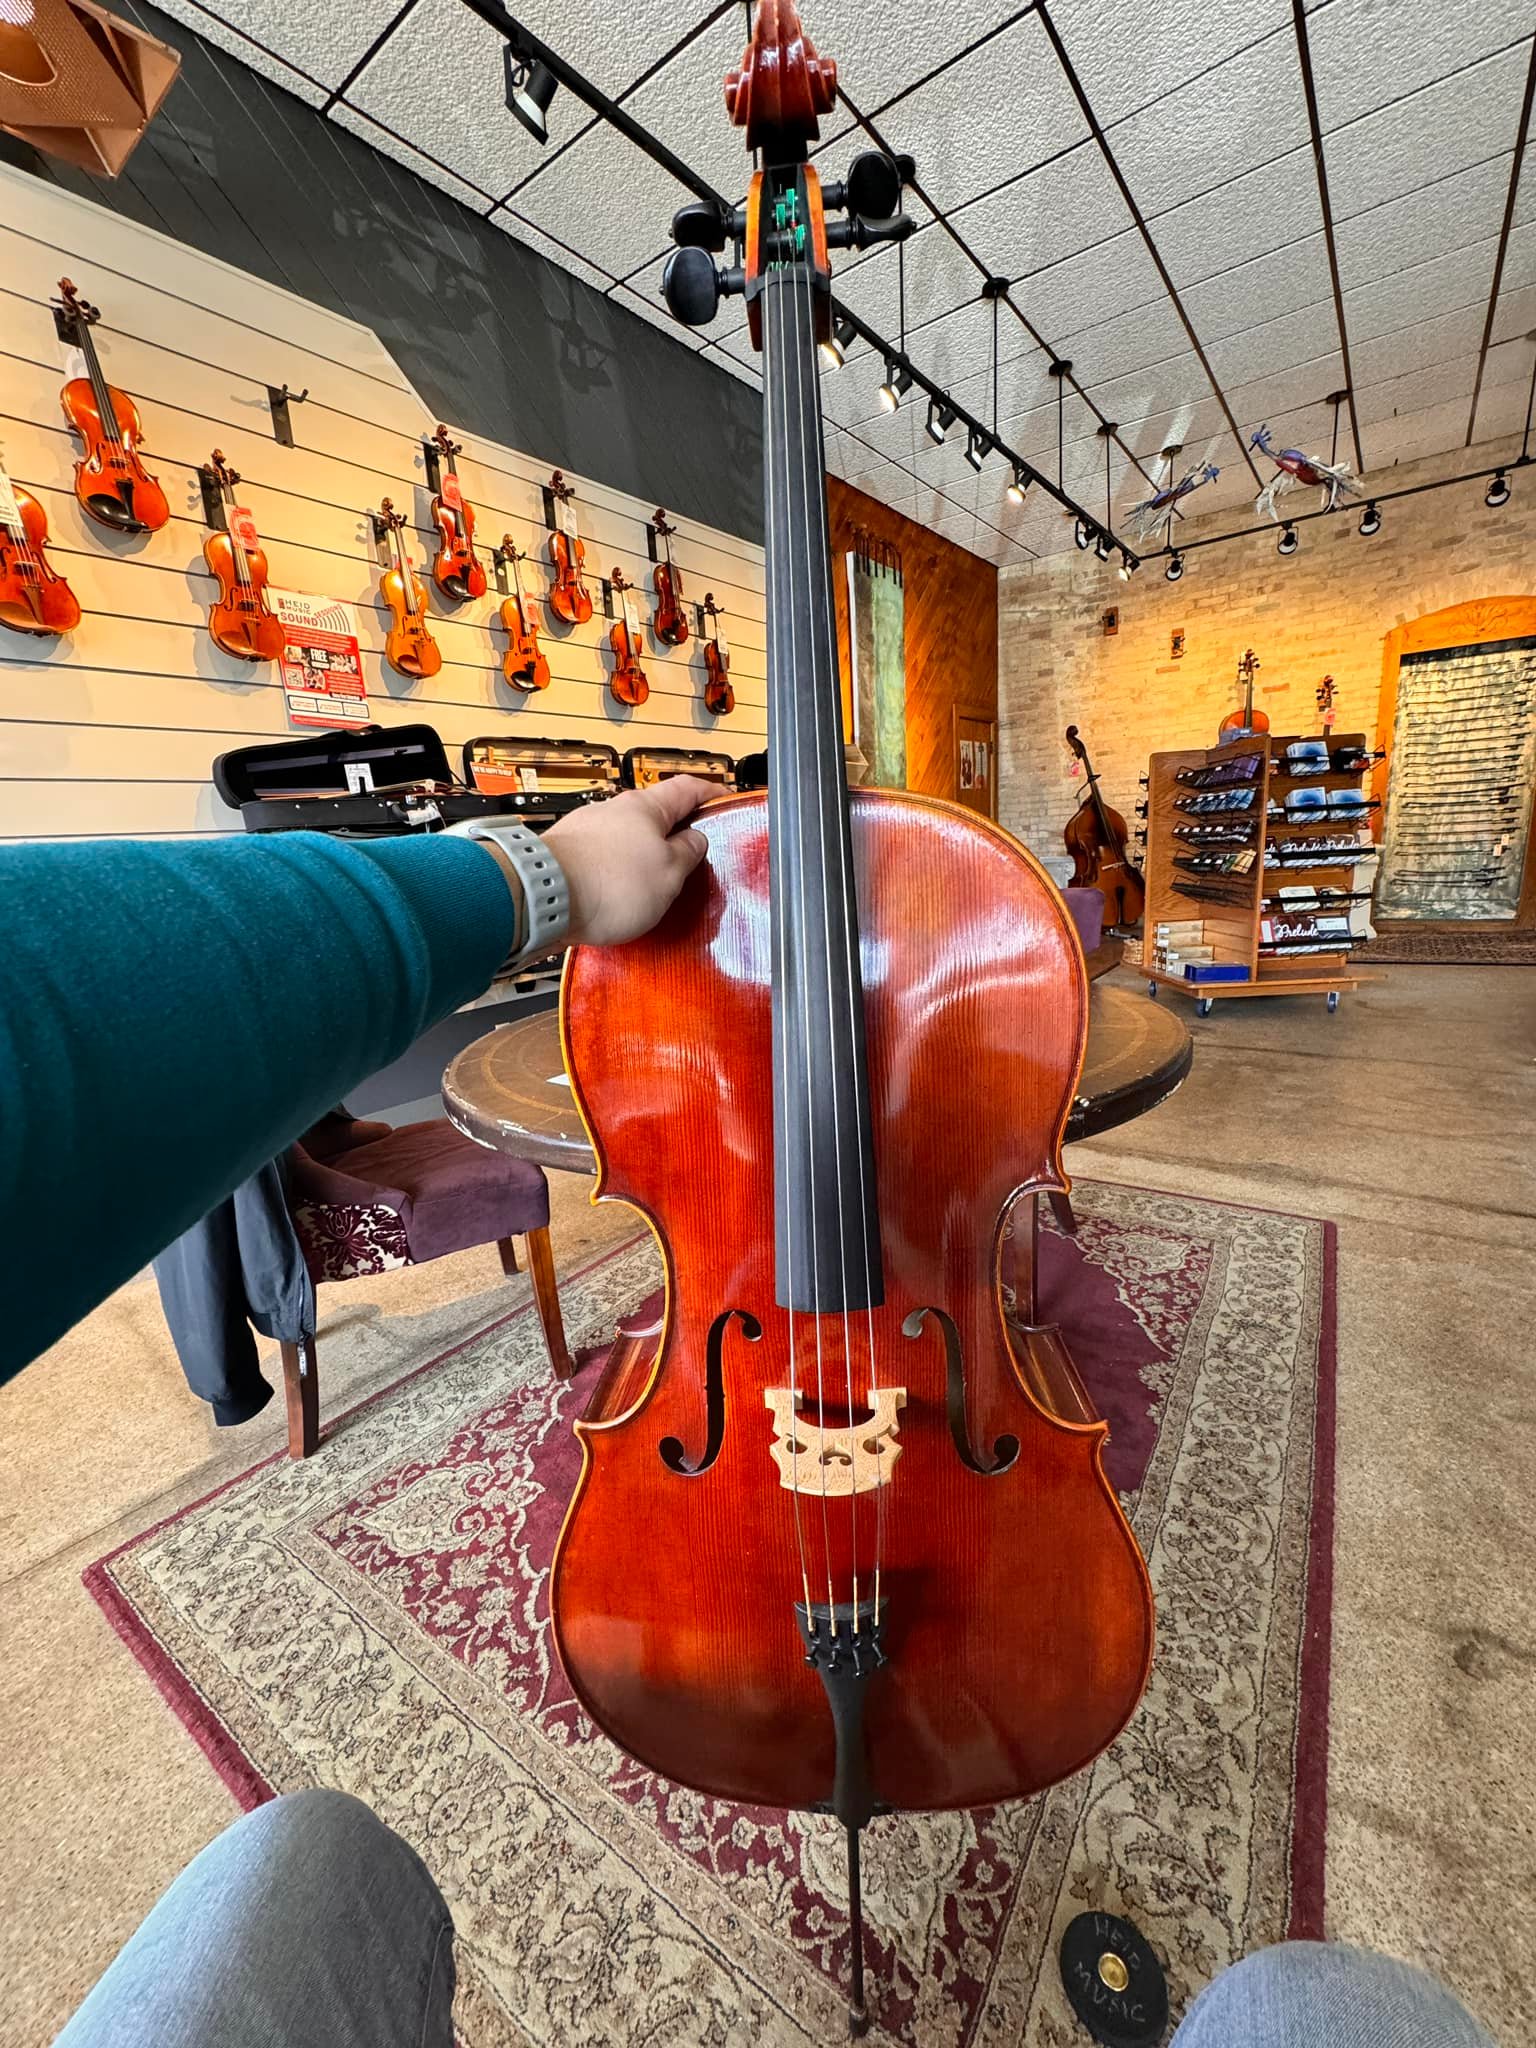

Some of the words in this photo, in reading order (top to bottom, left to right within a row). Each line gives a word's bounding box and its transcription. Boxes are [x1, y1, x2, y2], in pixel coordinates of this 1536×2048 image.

[285, 599, 311, 610] HEID
[286, 606, 312, 615] MUSIC
[280, 612, 319, 627] SOUND
[310, 648, 329, 662] FREE
[1273, 923, 1319, 938] Prelude
[1094, 1915, 1141, 1970] HEID
[1074, 1961, 1146, 2023] MUSIC
